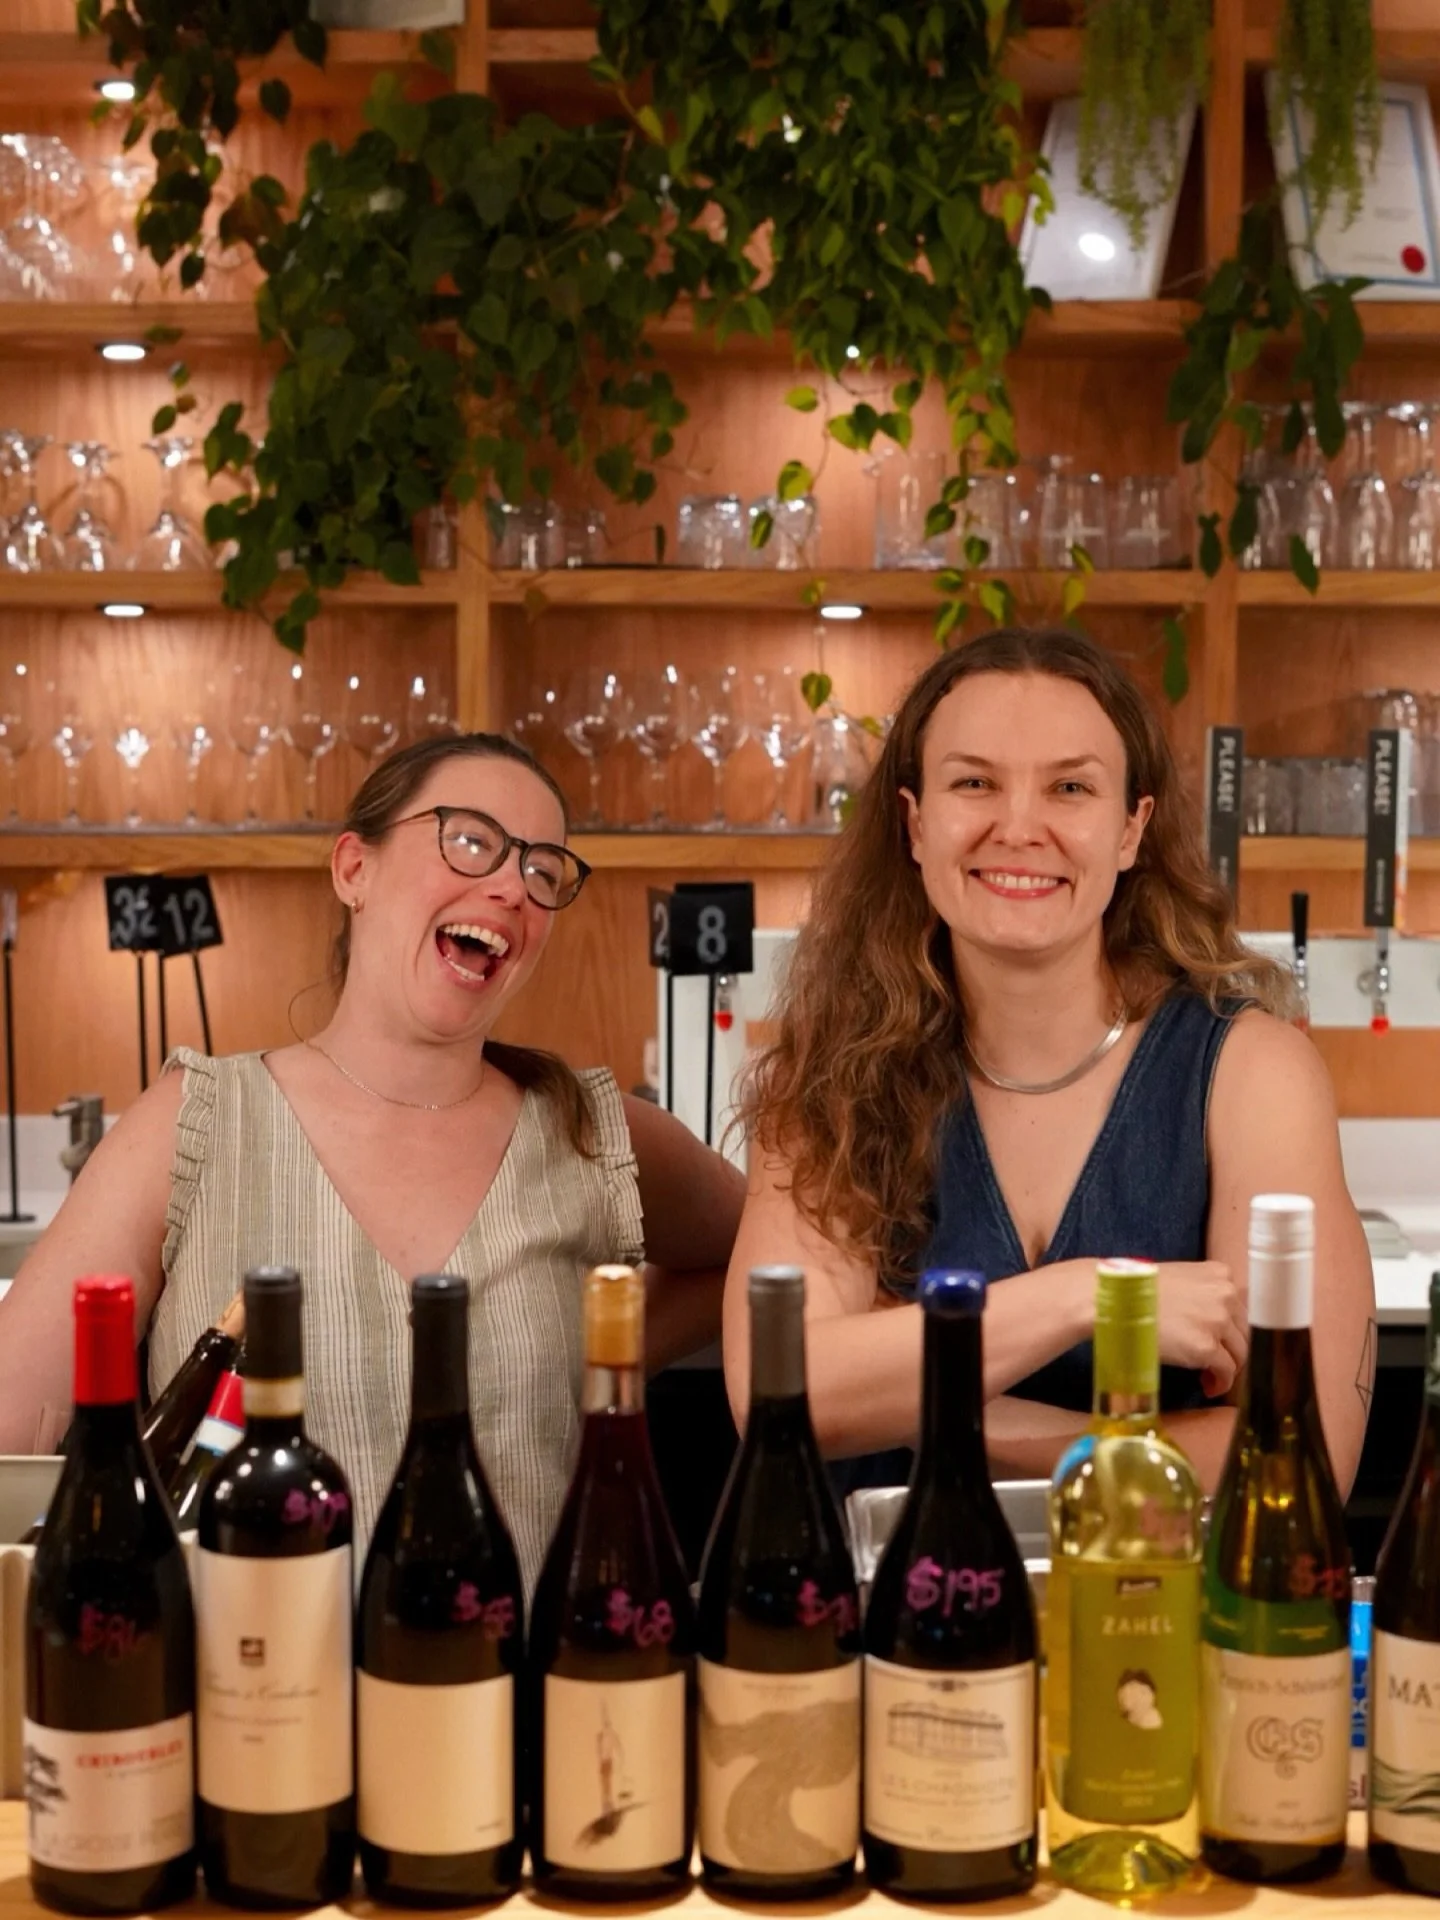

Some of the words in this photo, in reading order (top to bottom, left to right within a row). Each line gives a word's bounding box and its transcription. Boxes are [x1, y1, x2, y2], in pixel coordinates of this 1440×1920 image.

[163, 887, 215, 946] 12
[697, 904, 727, 964] 8
[906, 1555, 1005, 1617] $195
[605, 1587, 677, 1648] $68
[1101, 1613, 1174, 1636] ZAHEL
[1388, 1673, 1440, 1709] MA
